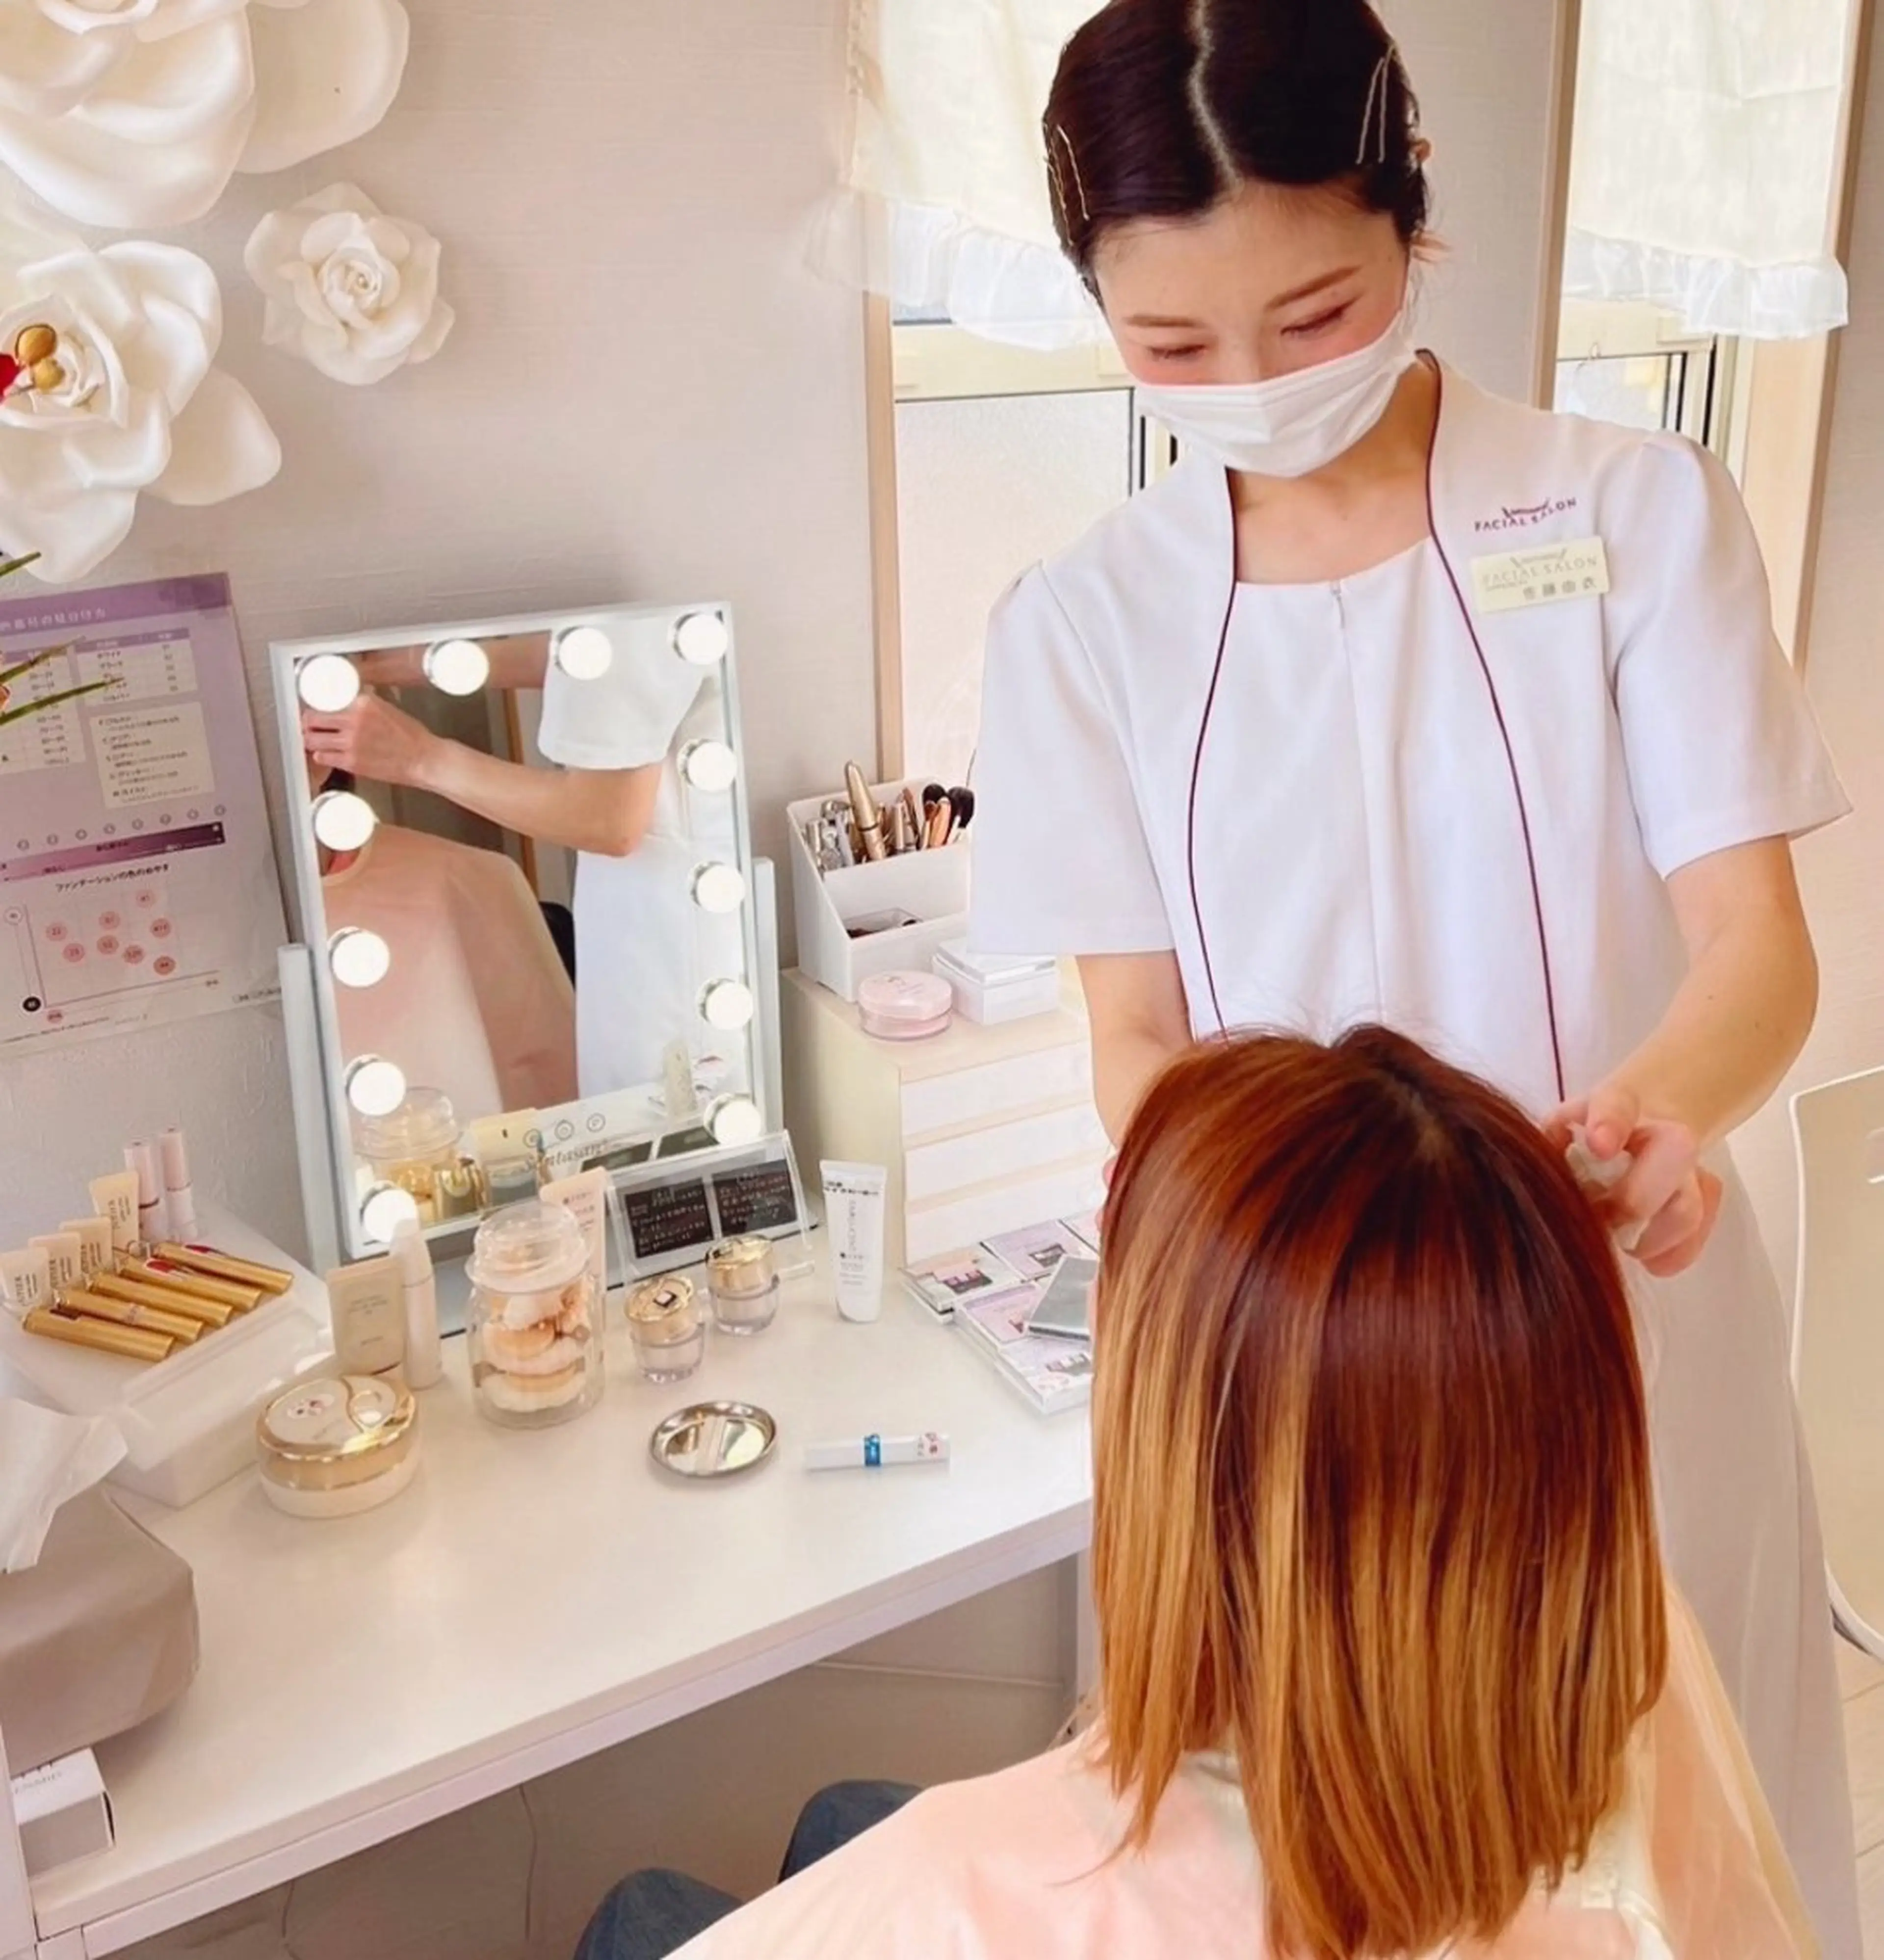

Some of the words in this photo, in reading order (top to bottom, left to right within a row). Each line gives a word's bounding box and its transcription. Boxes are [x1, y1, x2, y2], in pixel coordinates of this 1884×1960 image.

[1474, 517, 1527, 532] FACIAL
[1531, 497, 1577, 523] SALON
[1482, 566, 1539, 585] FACIAL
[1544, 555, 1597, 574] SALON
